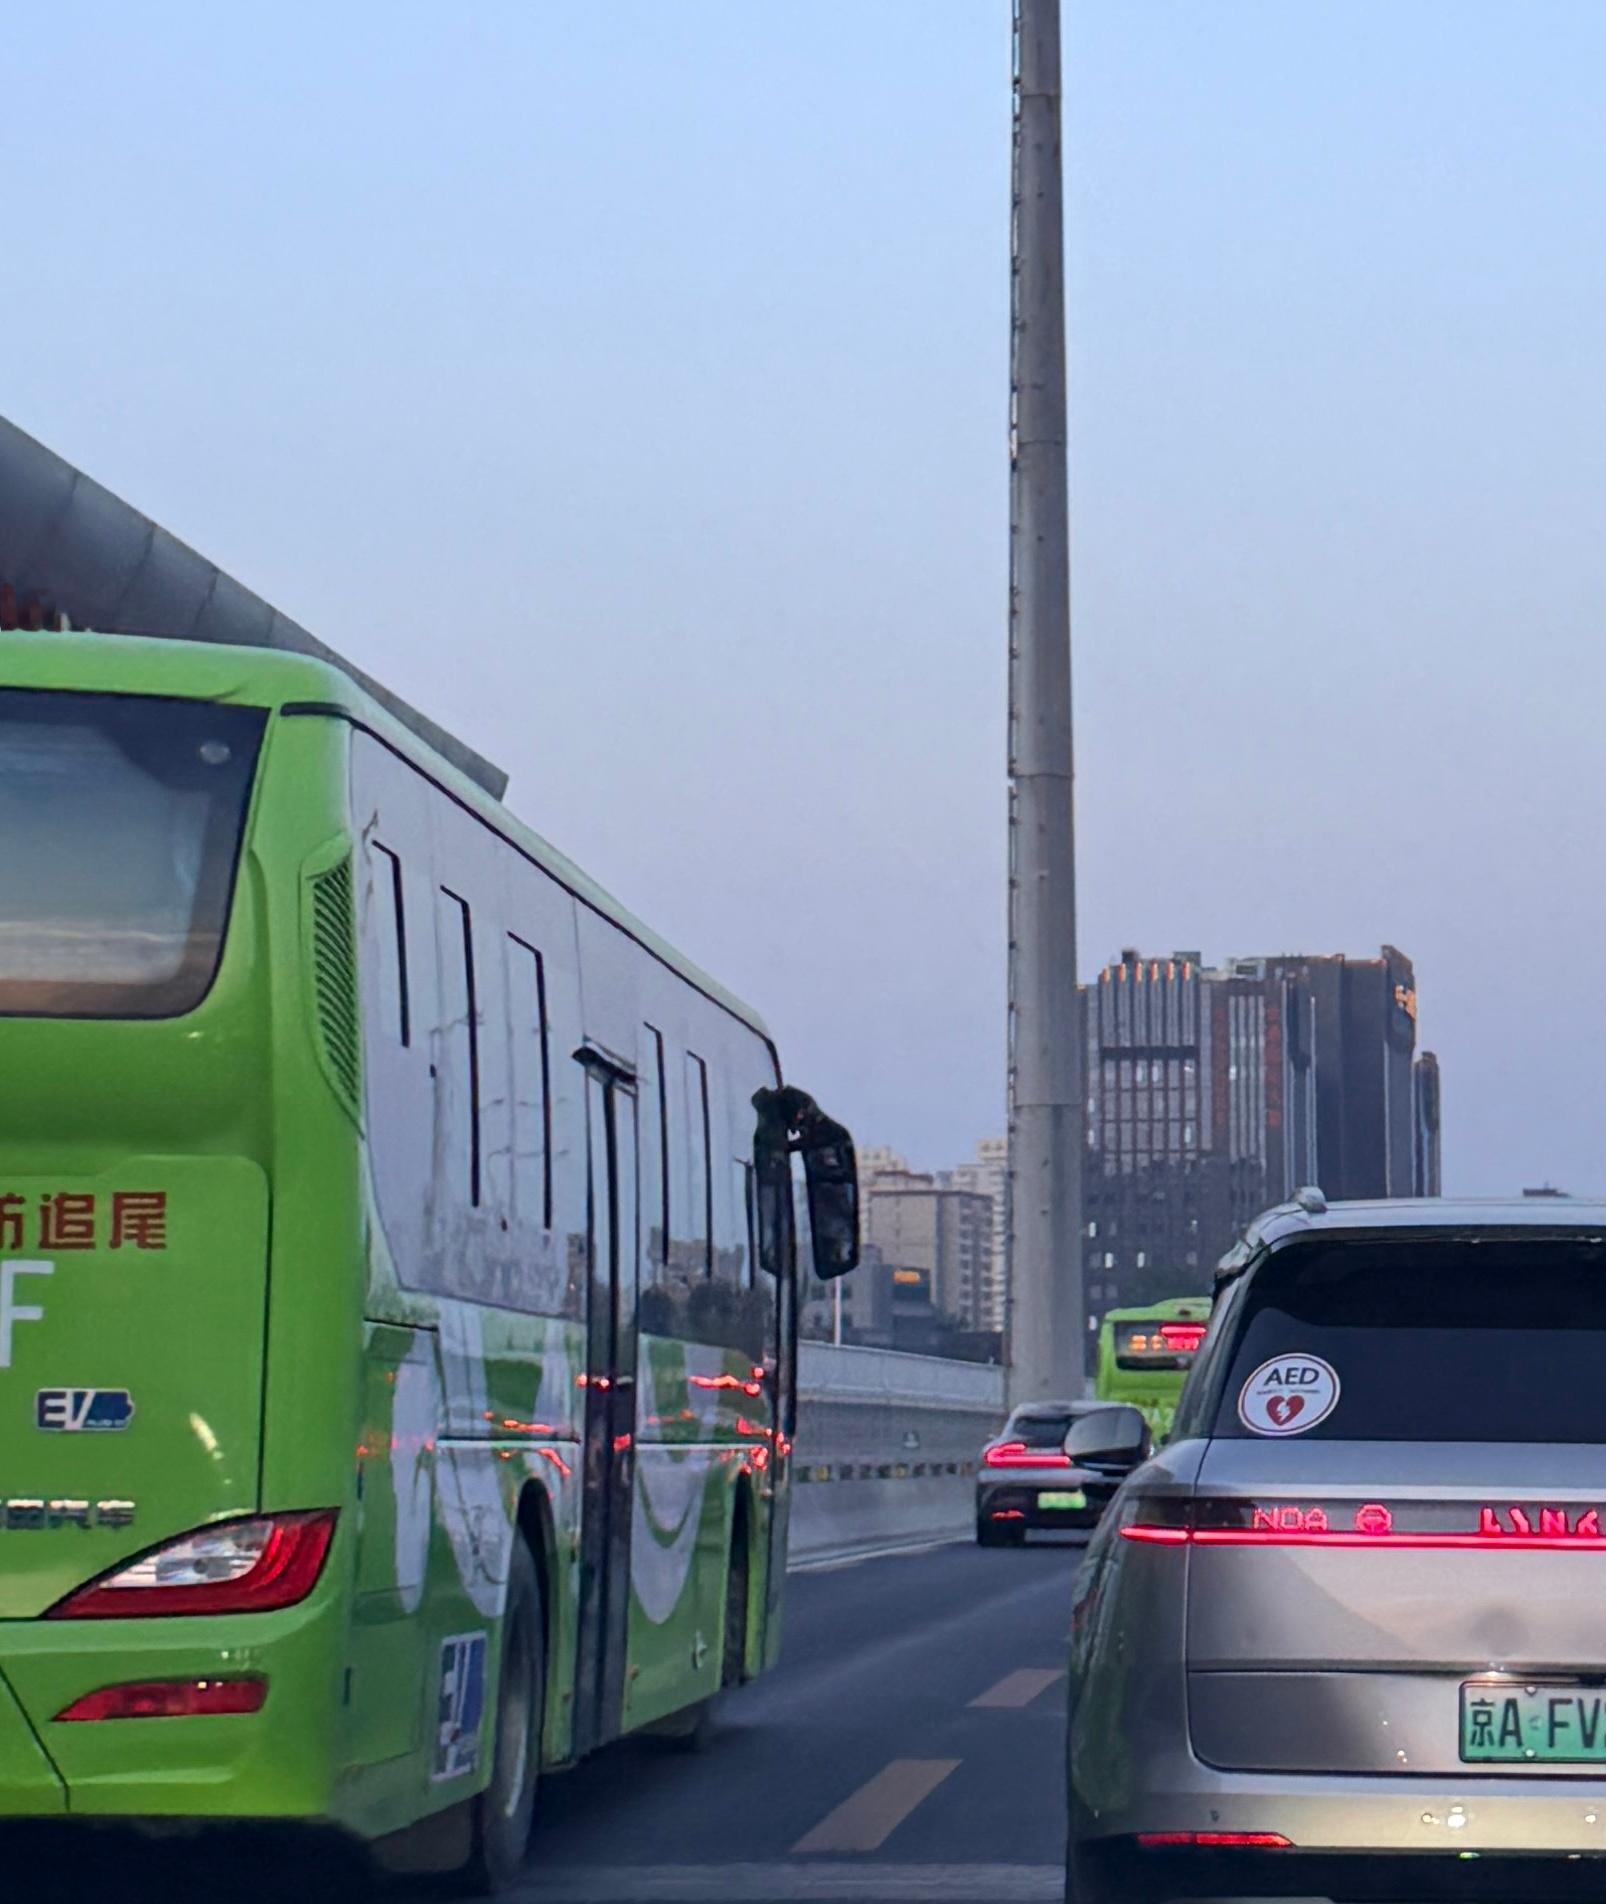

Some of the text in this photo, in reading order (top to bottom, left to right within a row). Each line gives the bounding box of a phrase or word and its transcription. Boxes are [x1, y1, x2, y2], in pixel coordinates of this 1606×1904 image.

[1263, 1367, 1320, 1386] AED
[37, 1389, 96, 1430] EV
[1254, 1507, 1328, 1530] NOA
[1469, 1698, 1523, 1747] 京A
